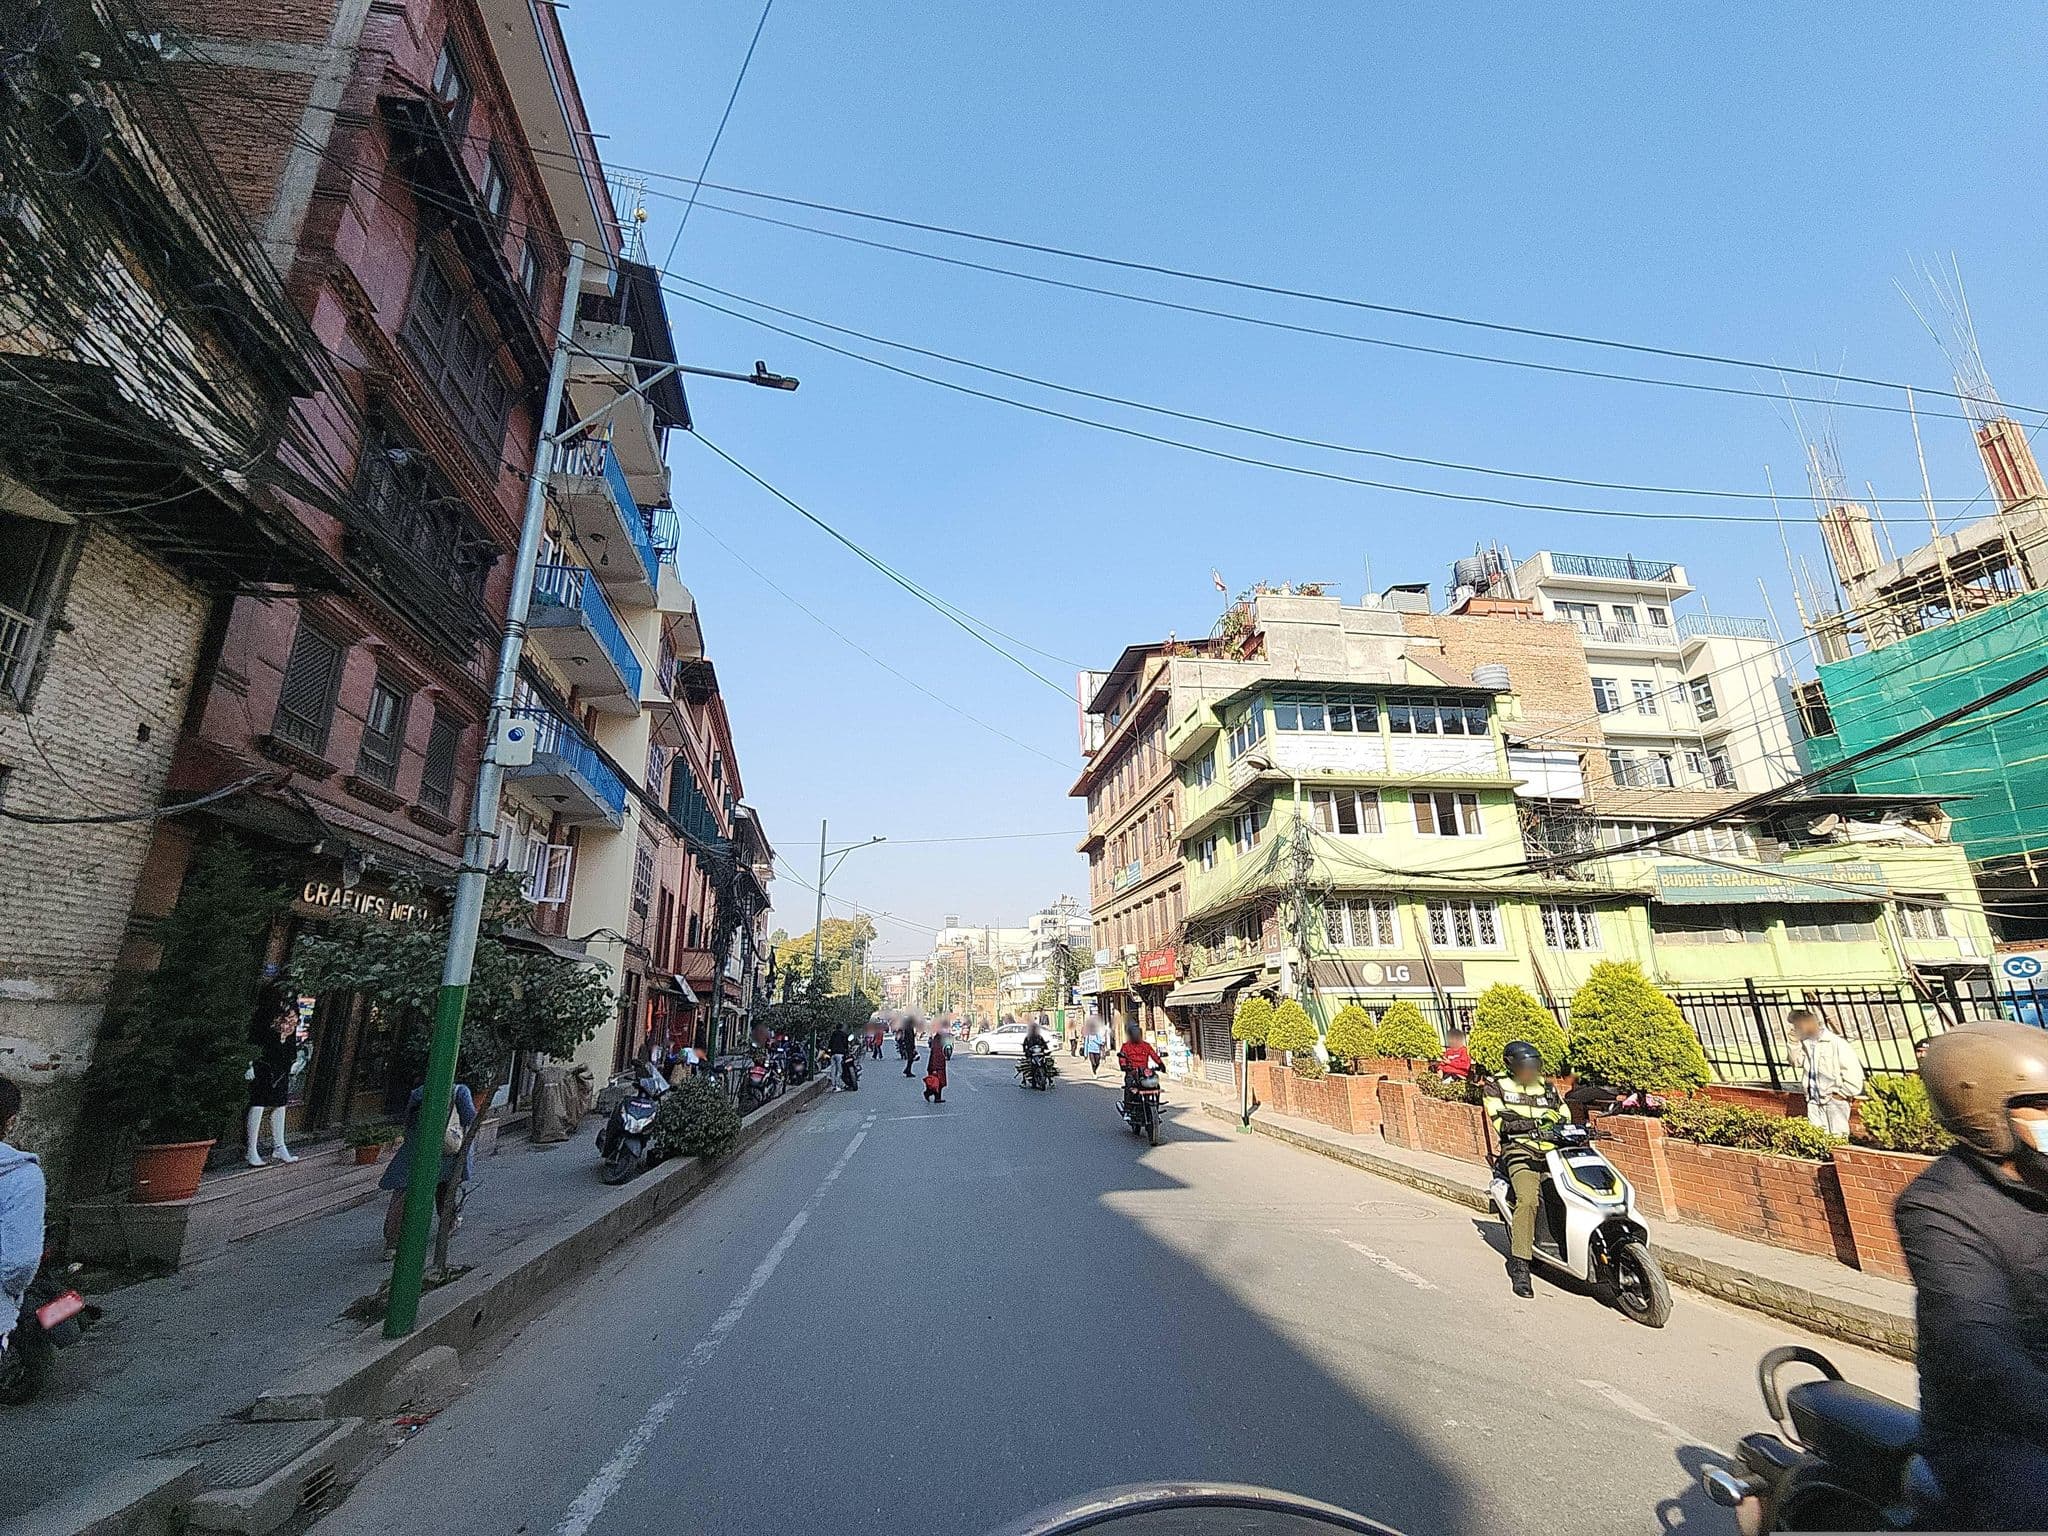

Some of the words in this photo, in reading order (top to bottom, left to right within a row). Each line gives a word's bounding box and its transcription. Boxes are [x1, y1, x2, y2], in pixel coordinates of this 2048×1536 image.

[1661, 873, 1708, 887] BUDDHI
[1268, 934, 1278, 949] LG
[1385, 965, 1410, 982] LG
[2007, 960, 2037, 975] CG
